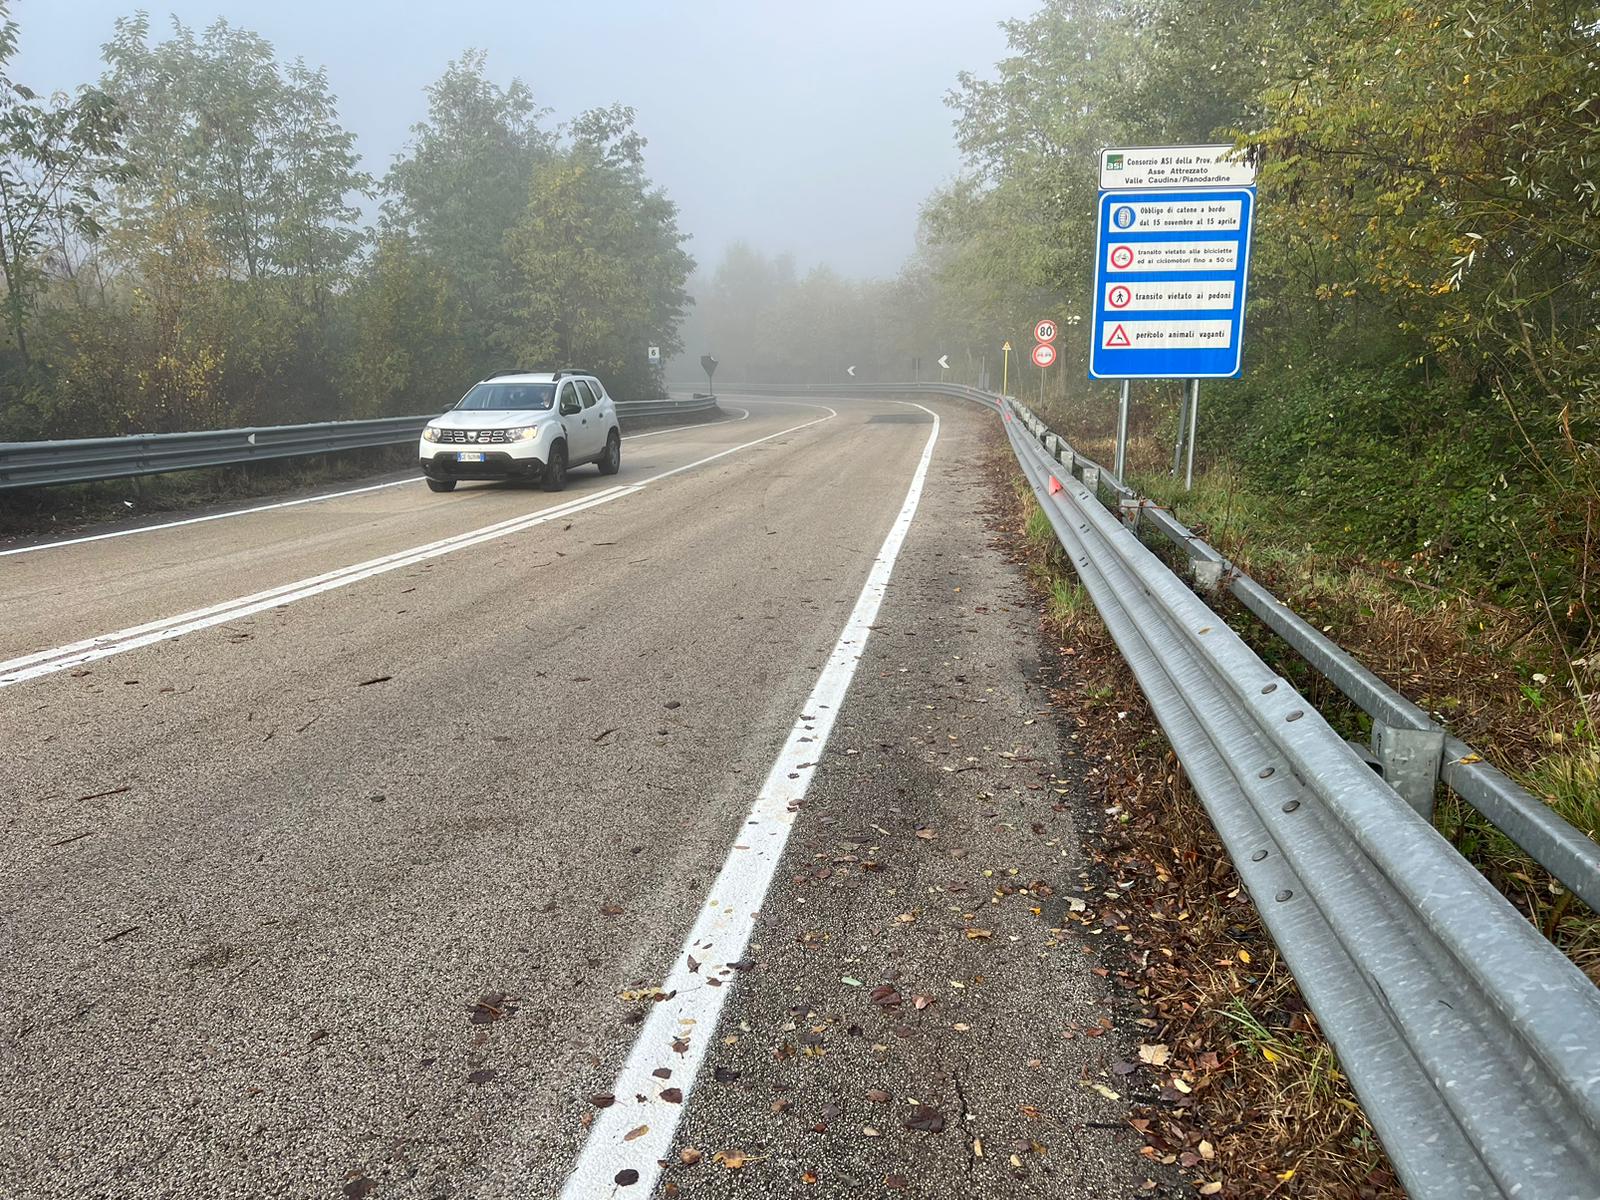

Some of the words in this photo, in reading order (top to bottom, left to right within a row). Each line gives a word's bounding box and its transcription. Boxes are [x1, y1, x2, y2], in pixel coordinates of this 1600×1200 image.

[1127, 157, 1158, 166] Consorzio
[1176, 156, 1192, 164] della
[1196, 156, 1212, 164] Prov.
[1140, 206, 1163, 215] Obbligo
[1208, 292, 1231, 300] pedoni
[1040, 326, 1052, 336] 80
[1136, 331, 1164, 340] pericolo
